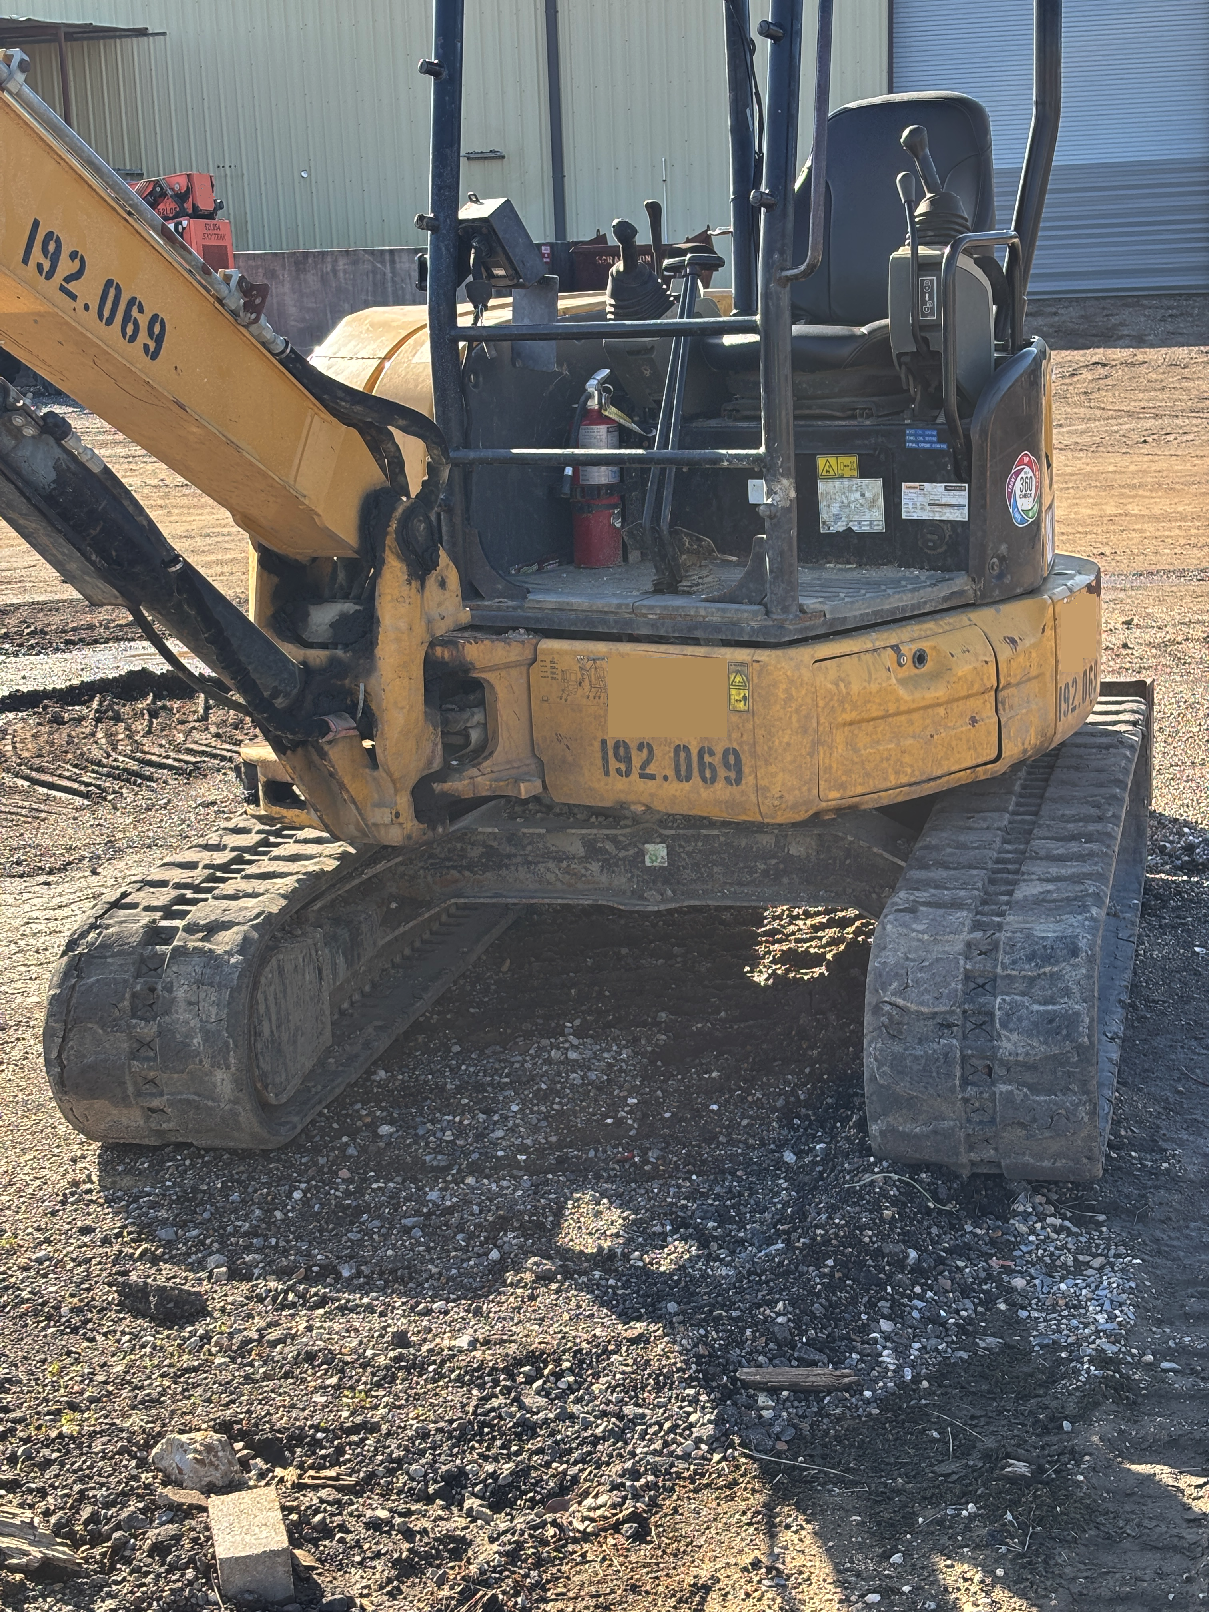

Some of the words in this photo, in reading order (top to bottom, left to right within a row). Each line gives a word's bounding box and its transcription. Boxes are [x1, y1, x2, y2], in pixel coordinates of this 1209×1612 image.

[595, 255, 620, 264] SCRA
[21, 217, 167, 361] 192.069
[1019, 476, 1033, 493] 360
[1059, 659, 1097, 722] 192.069
[600, 738, 743, 787] 192.069
